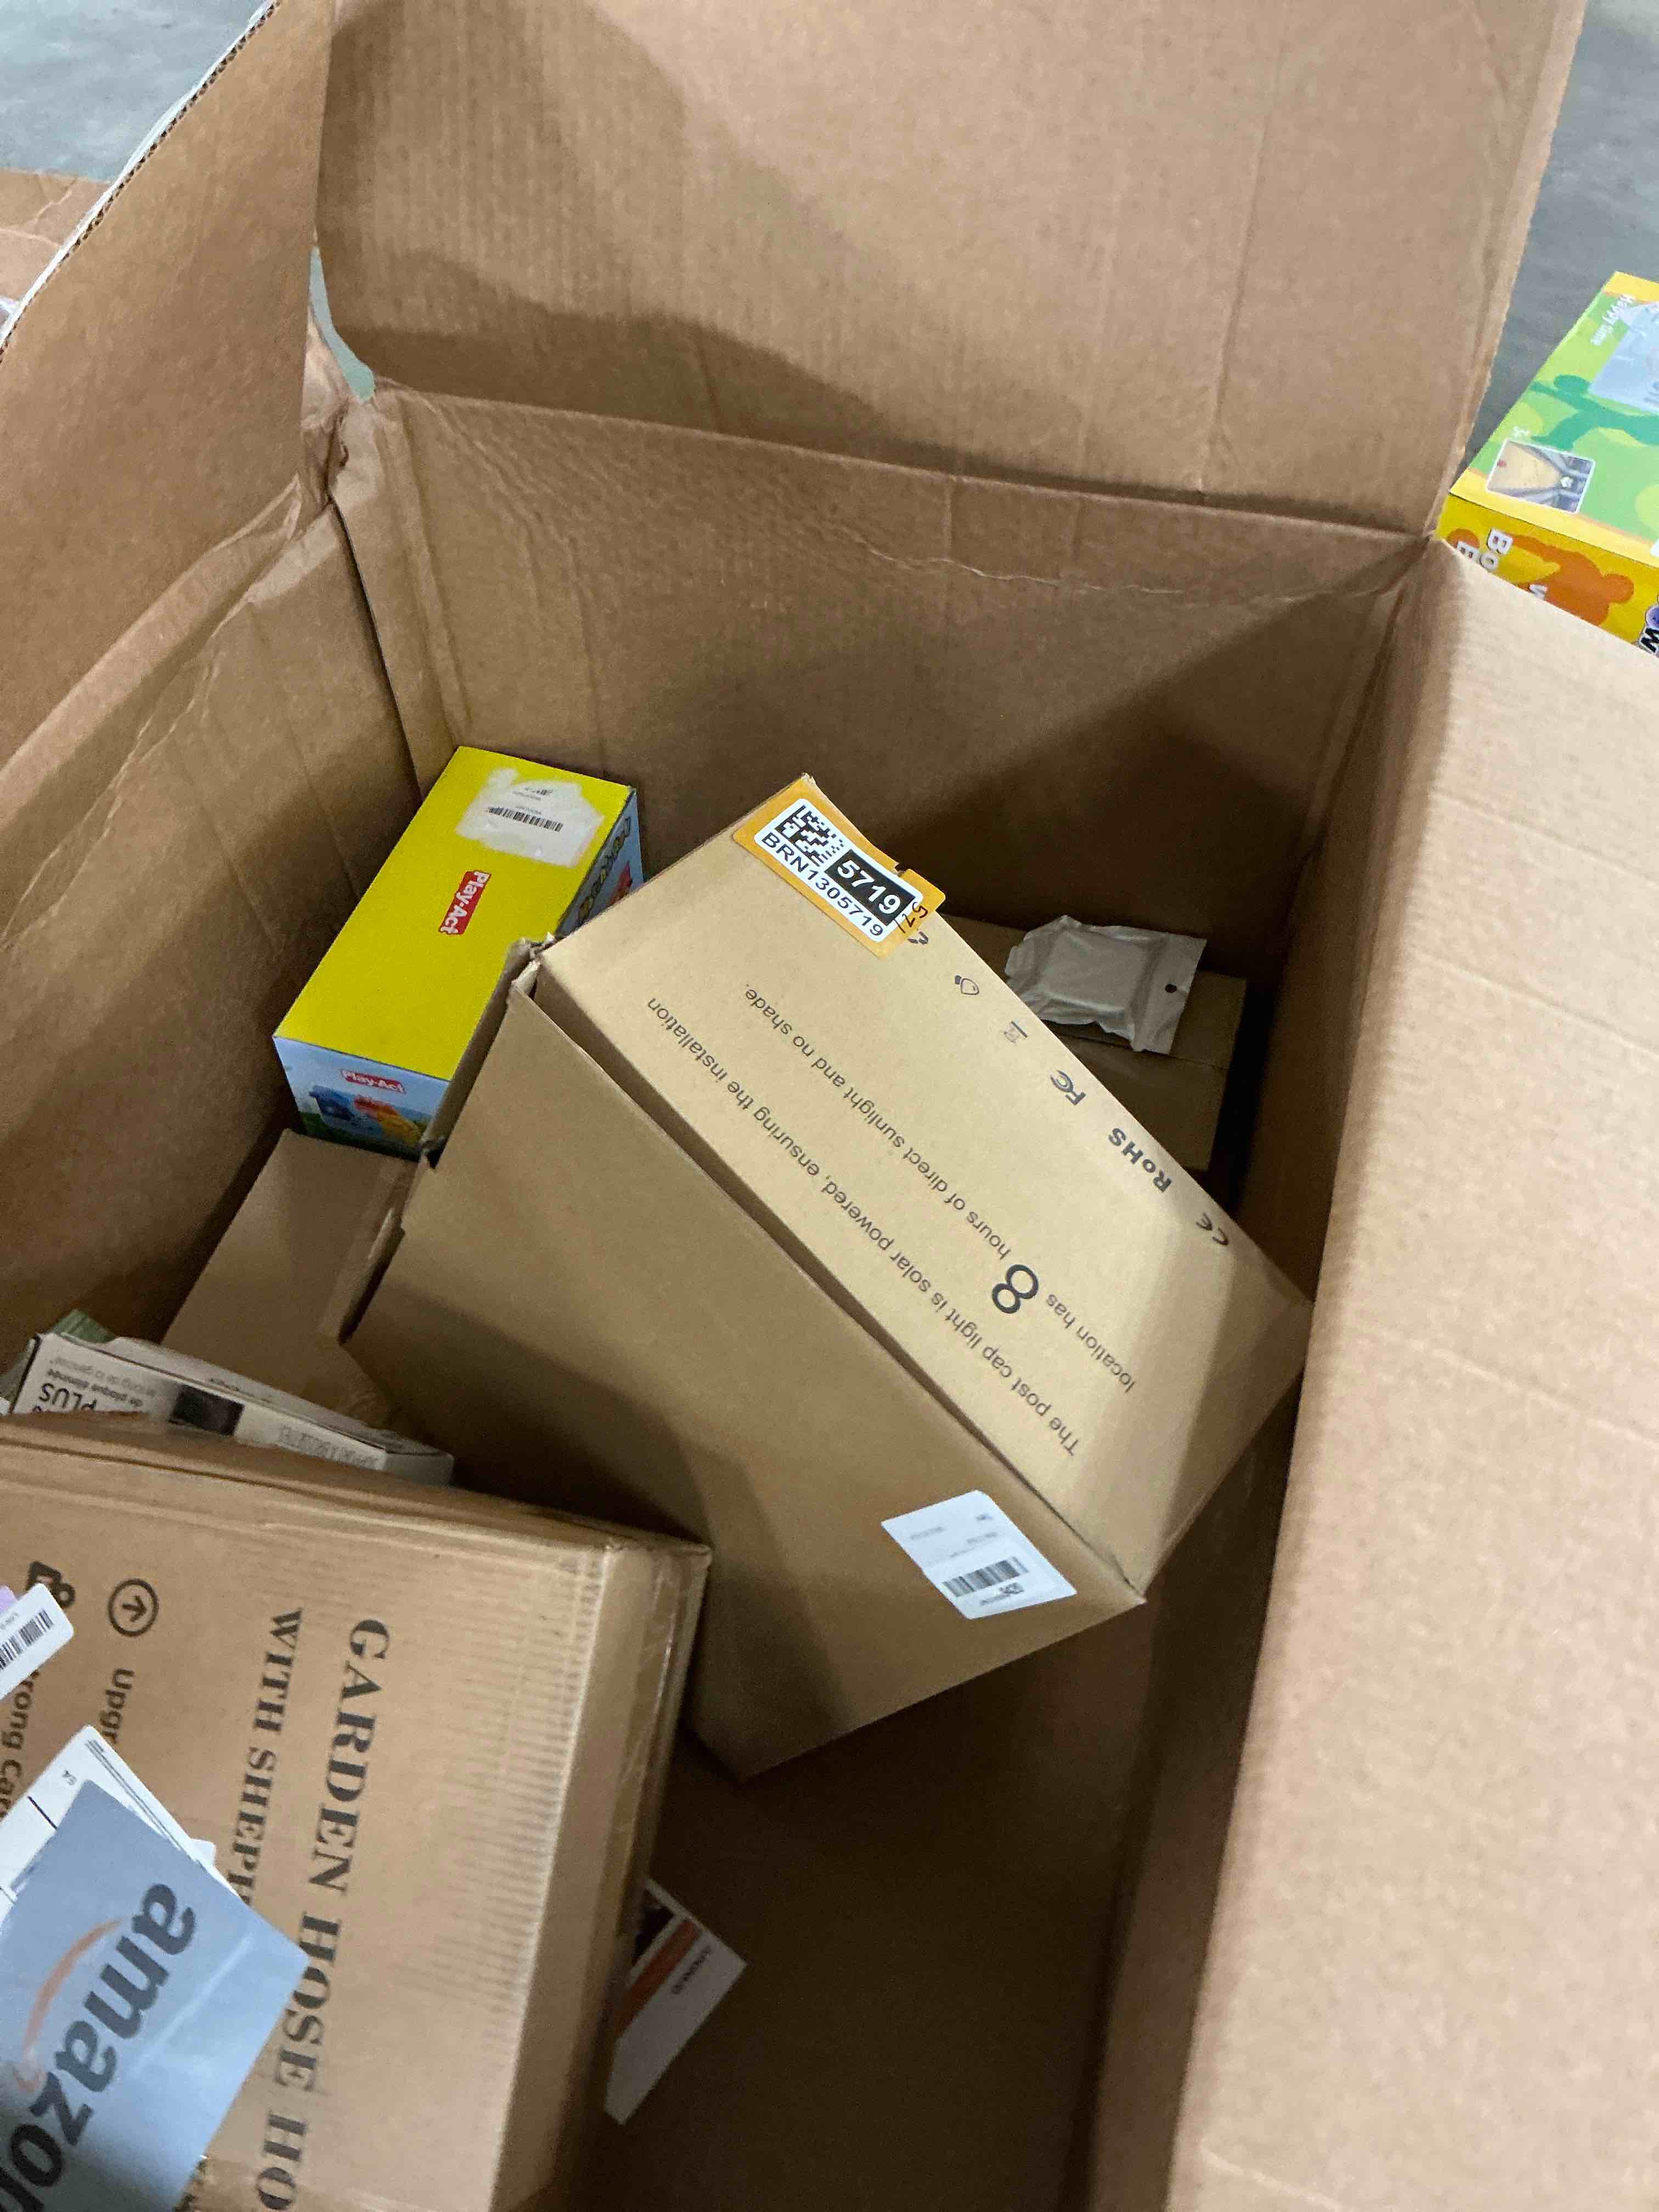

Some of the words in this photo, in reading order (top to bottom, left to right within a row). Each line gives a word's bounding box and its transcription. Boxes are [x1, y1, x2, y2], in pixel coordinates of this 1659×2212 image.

[761, 831, 884, 938] BRN1305719
[836, 859, 902, 916] 5719
[744, 983, 794, 1036] shade.
[647, 997, 727, 1082] installation
[793, 1035, 815, 1058] no
[727, 1079, 754, 1111] the
[811, 1056, 846, 1088] and
[754, 1106, 820, 1178] ensuring
[843, 1087, 905, 1149] sunlight
[904, 1146, 947, 1192] direct
[1108, 1127, 1172, 1193] RoHS
[821, 1175, 894, 1251] powered,
[944, 1191, 966, 1212] of
[966, 1211, 1011, 1260] hours
[889, 1251, 932, 1293] solar
[991, 1264, 1039, 1314] 8
[932, 1291, 948, 1311] is
[1046, 1293, 1076, 1330] has
[944, 1307, 983, 1350] light
[981, 1345, 1013, 1379] cap
[1078, 1324, 1136, 1394] location
[1011, 1377, 1052, 1417] post
[1048, 1416, 1080, 1457] The
[254, 1607, 304, 1734] WITH
[308, 1618, 391, 1897] GARDEN
[275, 1911, 342, 2092] HOSE
[255, 2110, 308, 2211] HO
